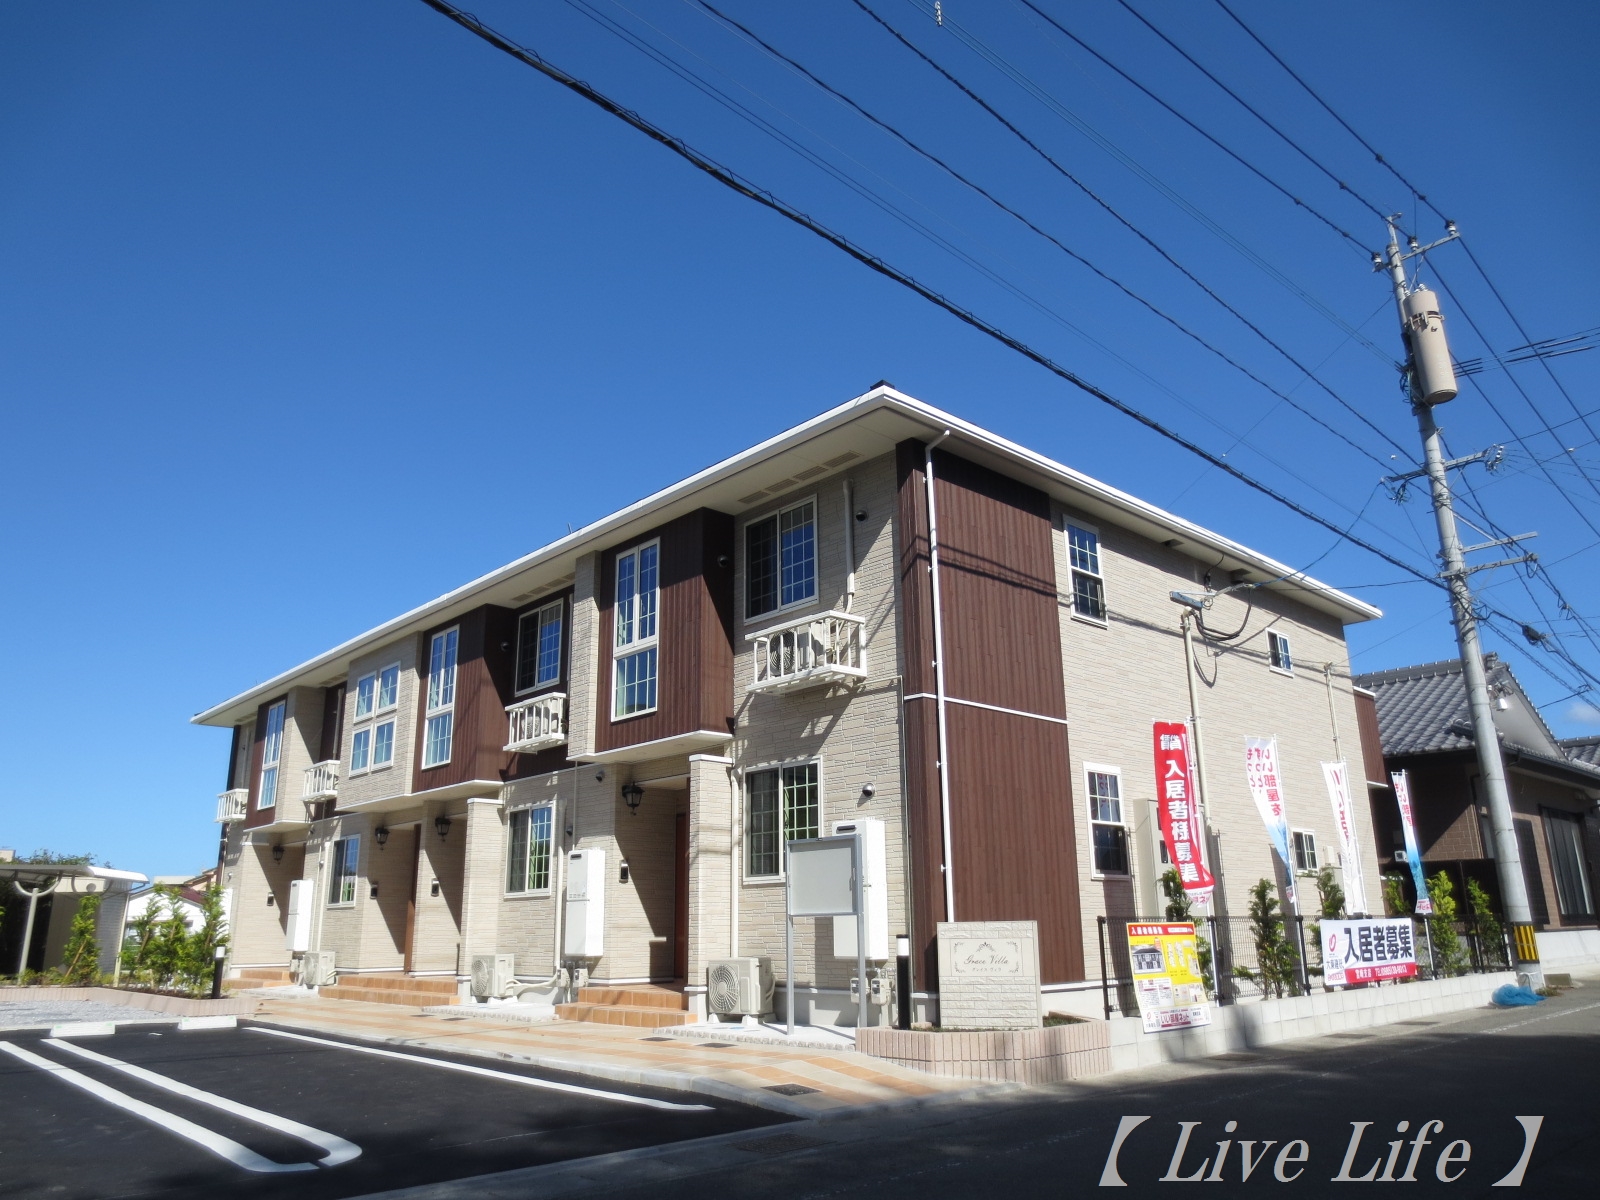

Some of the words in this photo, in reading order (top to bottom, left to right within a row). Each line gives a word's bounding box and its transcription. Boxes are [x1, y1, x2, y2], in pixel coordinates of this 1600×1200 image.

[1165, 759, 1200, 882] 入居者様募集
[964, 954, 986, 965] Grace
[990, 954, 1009, 965] Villa
[1343, 924, 1413, 963] 入居者募集
